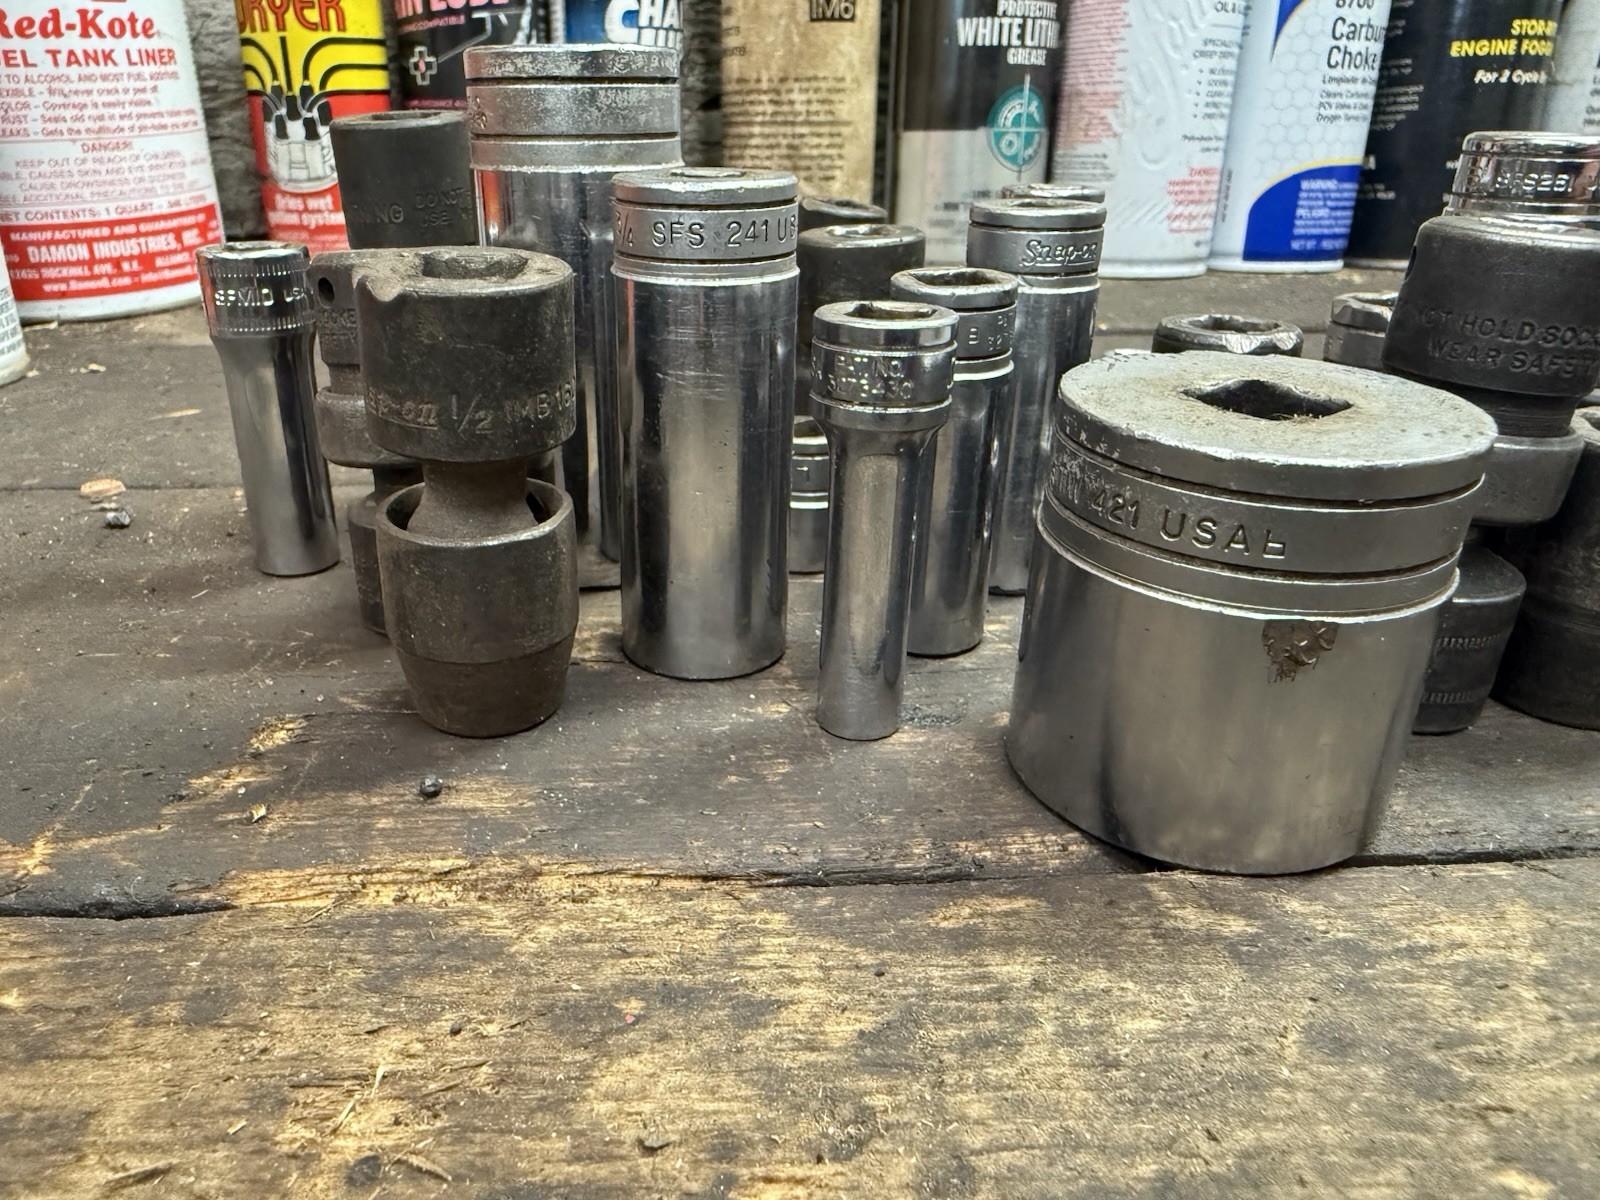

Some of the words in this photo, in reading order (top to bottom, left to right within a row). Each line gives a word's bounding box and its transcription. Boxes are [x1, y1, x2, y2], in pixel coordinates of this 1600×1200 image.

[957, 17, 1022, 47] WHITE
[0, 49, 38, 68] EL
[44, 48, 118, 68] TANK
[125, 48, 177, 67] LINER
[1006, 48, 1047, 66] GREASE
[1449, 38, 1517, 58] ENGINE
[1473, 69, 1498, 84] For
[1499, 69, 1511, 83] 2
[10, 226, 111, 241] MANUFACTURED
[651, 219, 705, 249] SFS
[726, 217, 769, 248] 241
[27, 243, 91, 264] DAMON
[1458, 312, 1537, 345] HOLD
[1090, 489, 1141, 530] 421
[1159, 507, 1251, 556] USA
